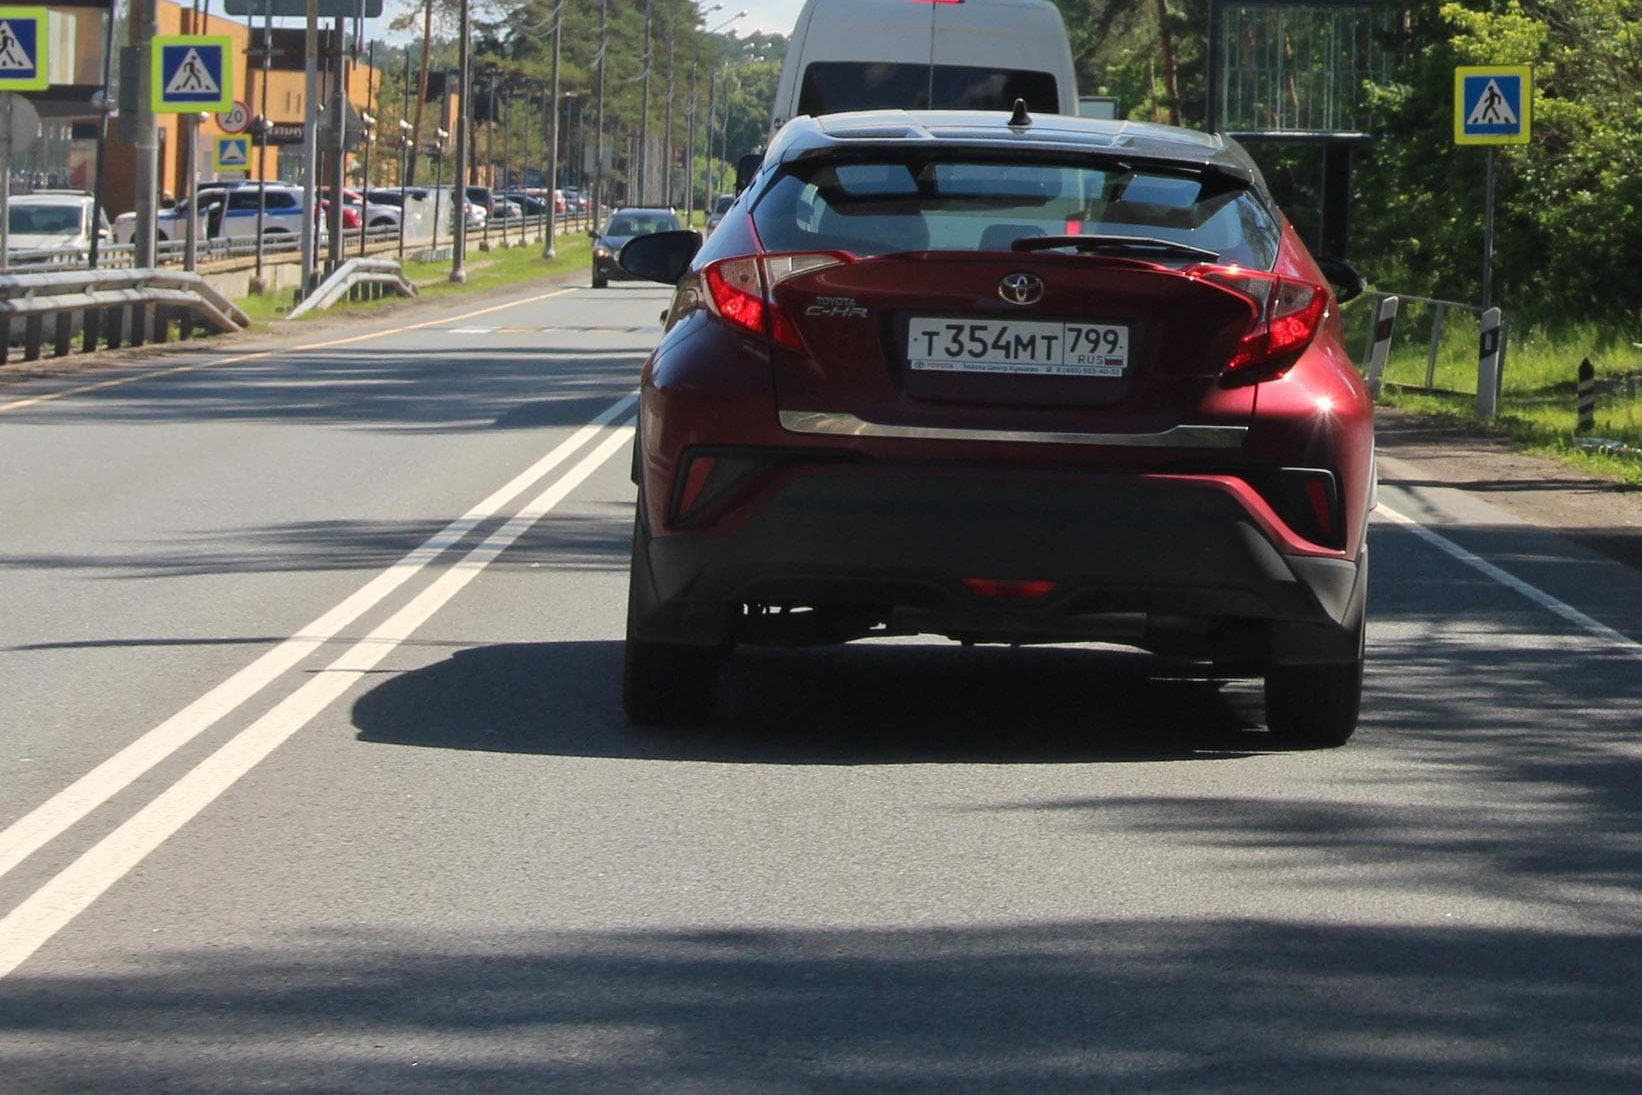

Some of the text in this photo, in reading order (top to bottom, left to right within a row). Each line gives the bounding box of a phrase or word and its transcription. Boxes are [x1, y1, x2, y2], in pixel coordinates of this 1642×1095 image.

[224, 110, 243, 124] 20
[816, 296, 857, 306] TOYOTA
[805, 305, 869, 318] C-HR
[1067, 327, 1120, 354] 799
[1078, 355, 1104, 365] RUS
